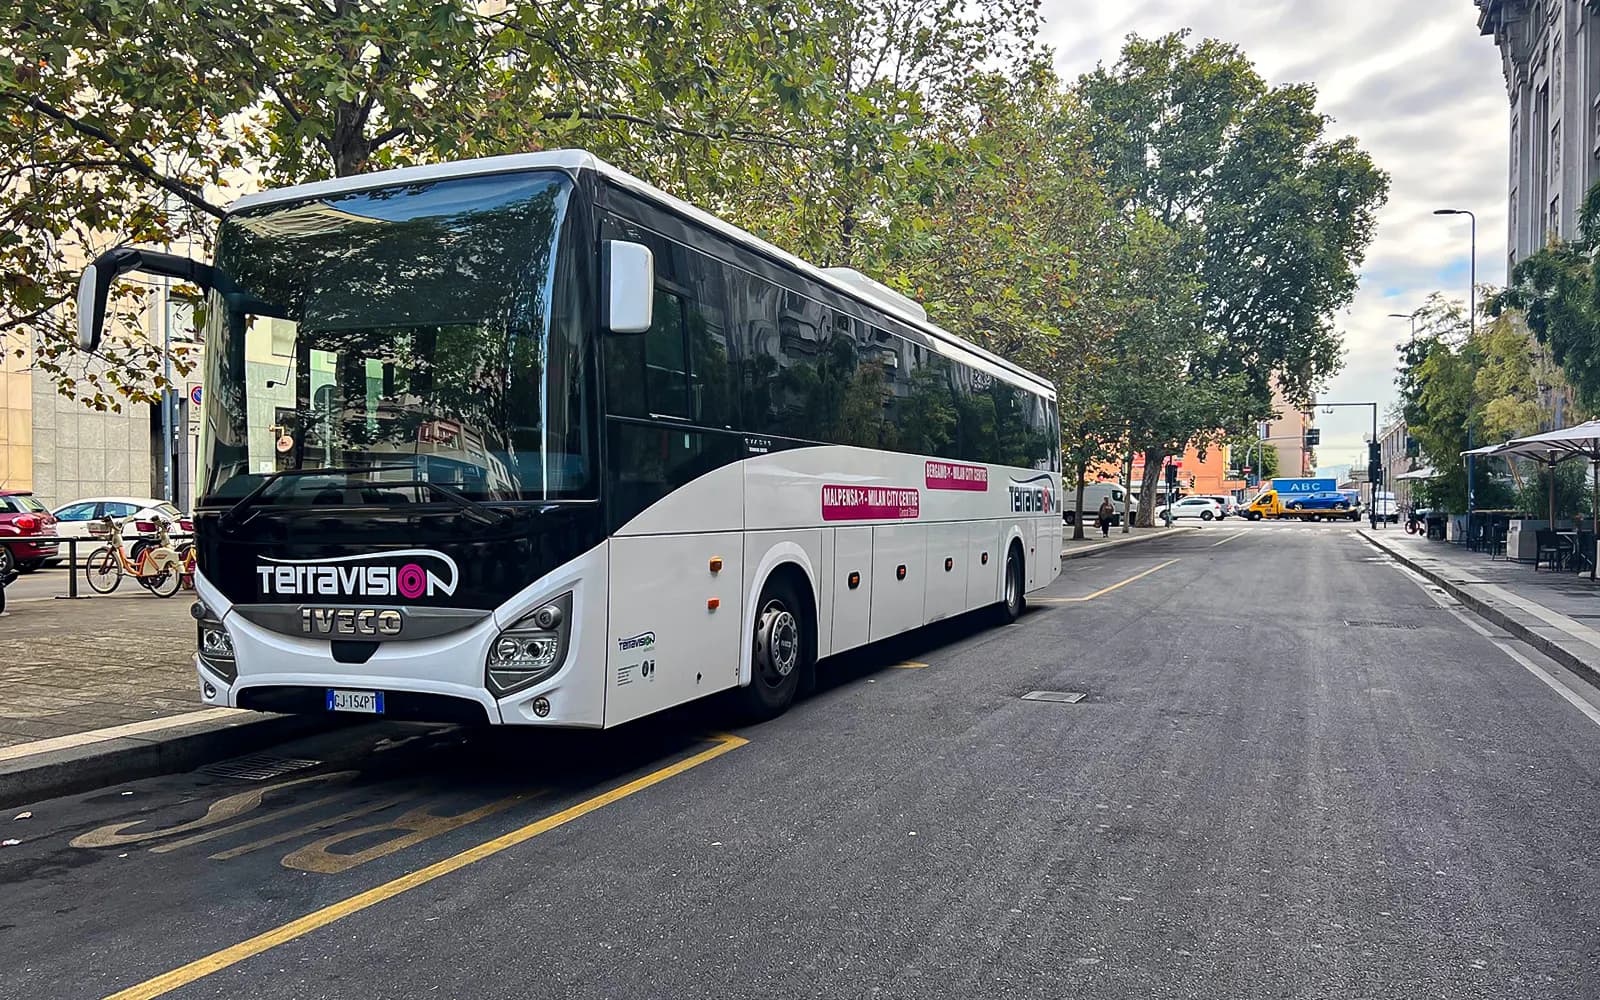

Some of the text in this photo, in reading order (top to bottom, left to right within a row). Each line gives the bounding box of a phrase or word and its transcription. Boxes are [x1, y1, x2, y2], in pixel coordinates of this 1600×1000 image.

[1290, 482, 1321, 491] ABC
[823, 487, 918, 506] MALPENSA MILAN CITY CENTRE
[302, 608, 402, 634] IVECO
